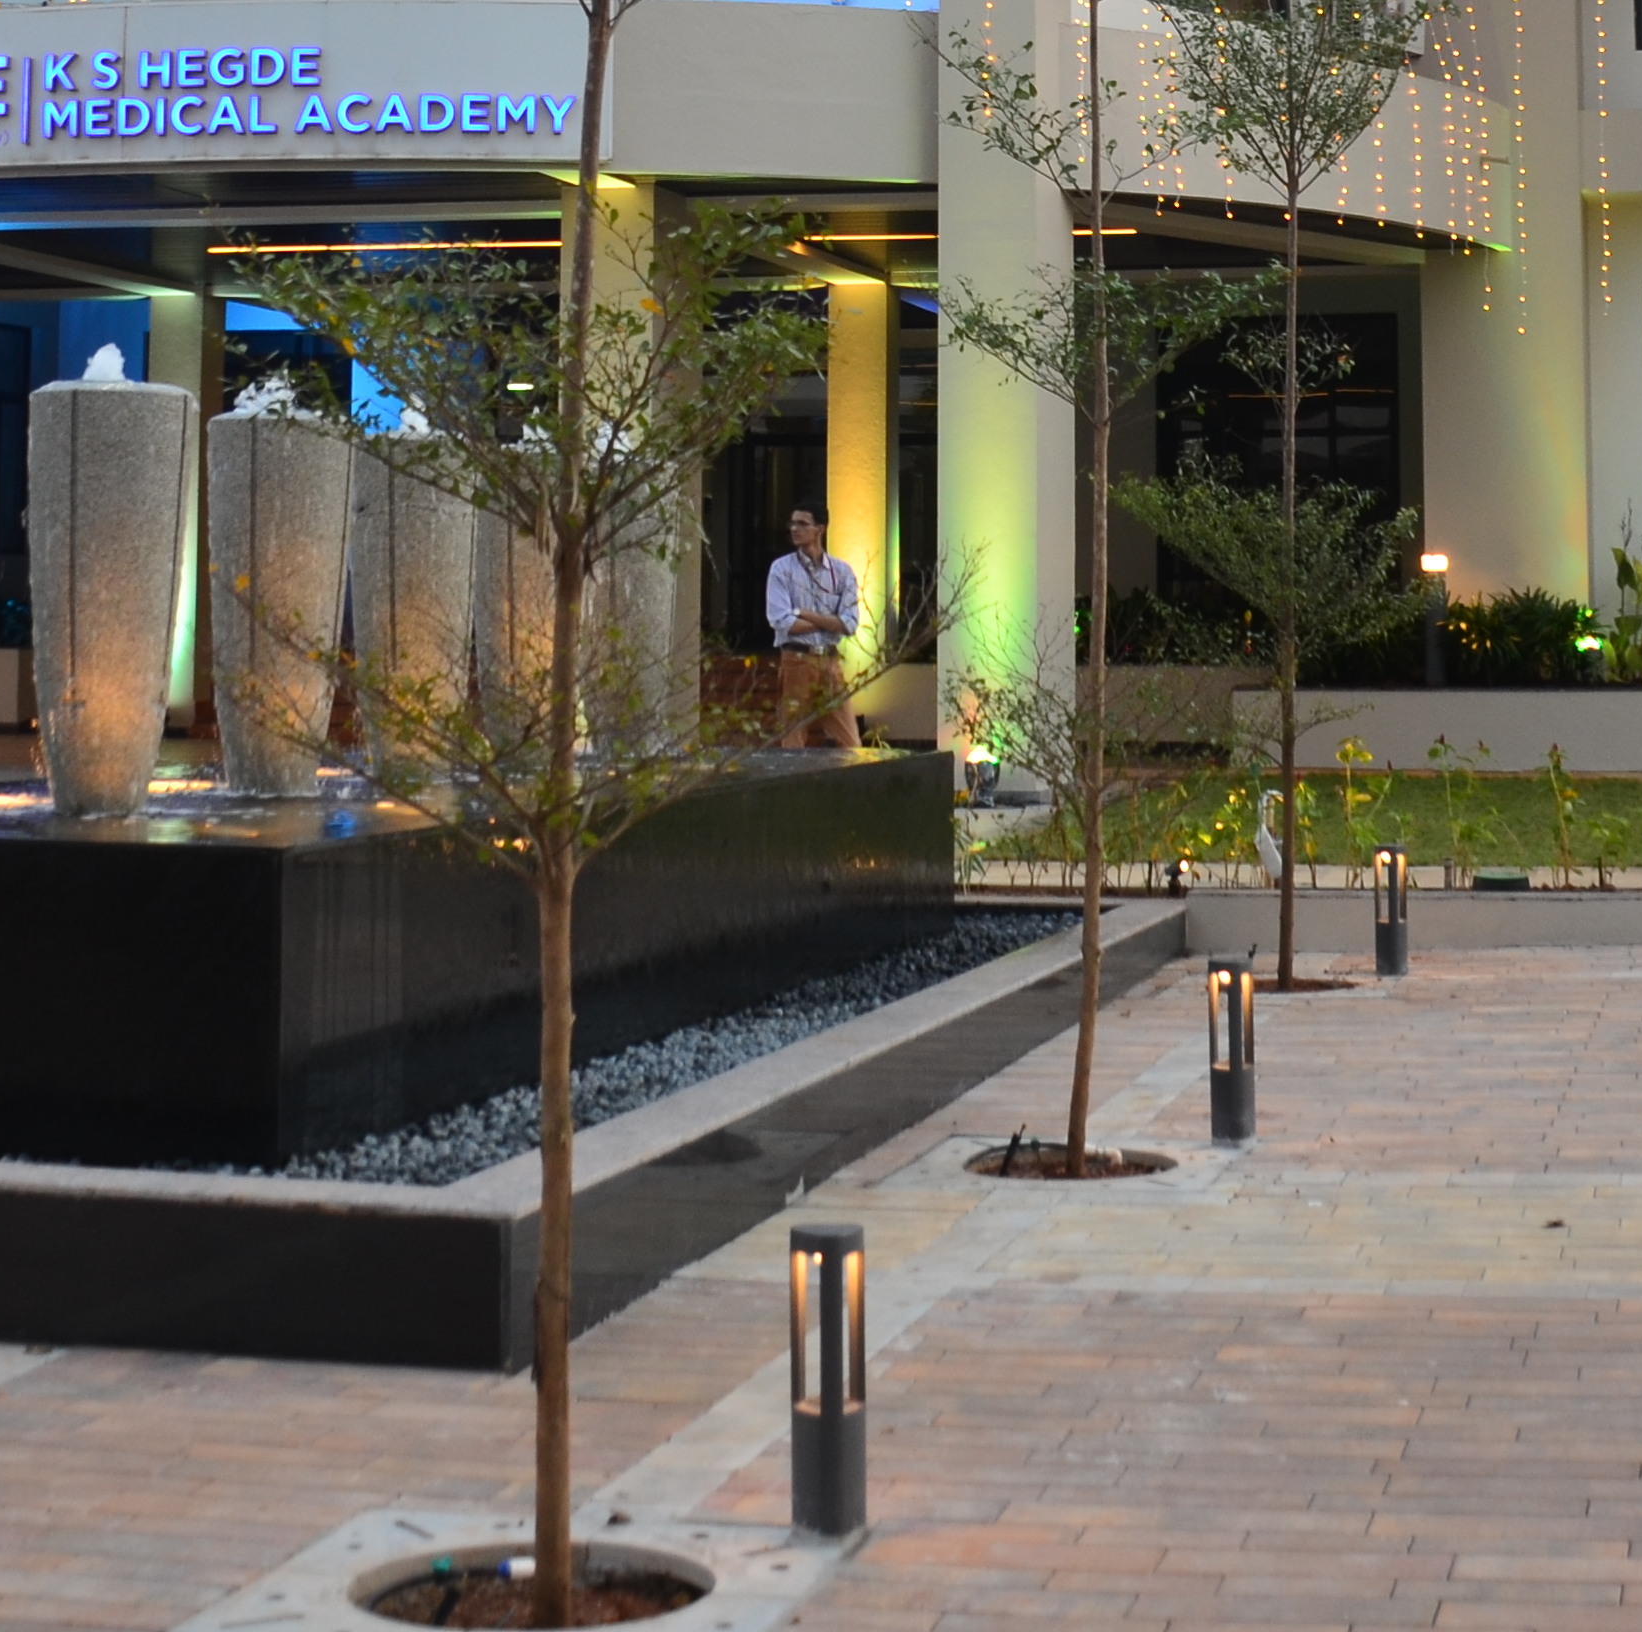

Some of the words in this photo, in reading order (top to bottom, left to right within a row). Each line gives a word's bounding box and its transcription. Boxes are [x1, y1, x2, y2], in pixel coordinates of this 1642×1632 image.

[43, 52, 77, 92] K
[90, 50, 121, 90] S
[138, 46, 322, 89] HEGDE
[41, 94, 278, 138] MEDICAL
[294, 93, 577, 135] ACADEMY
